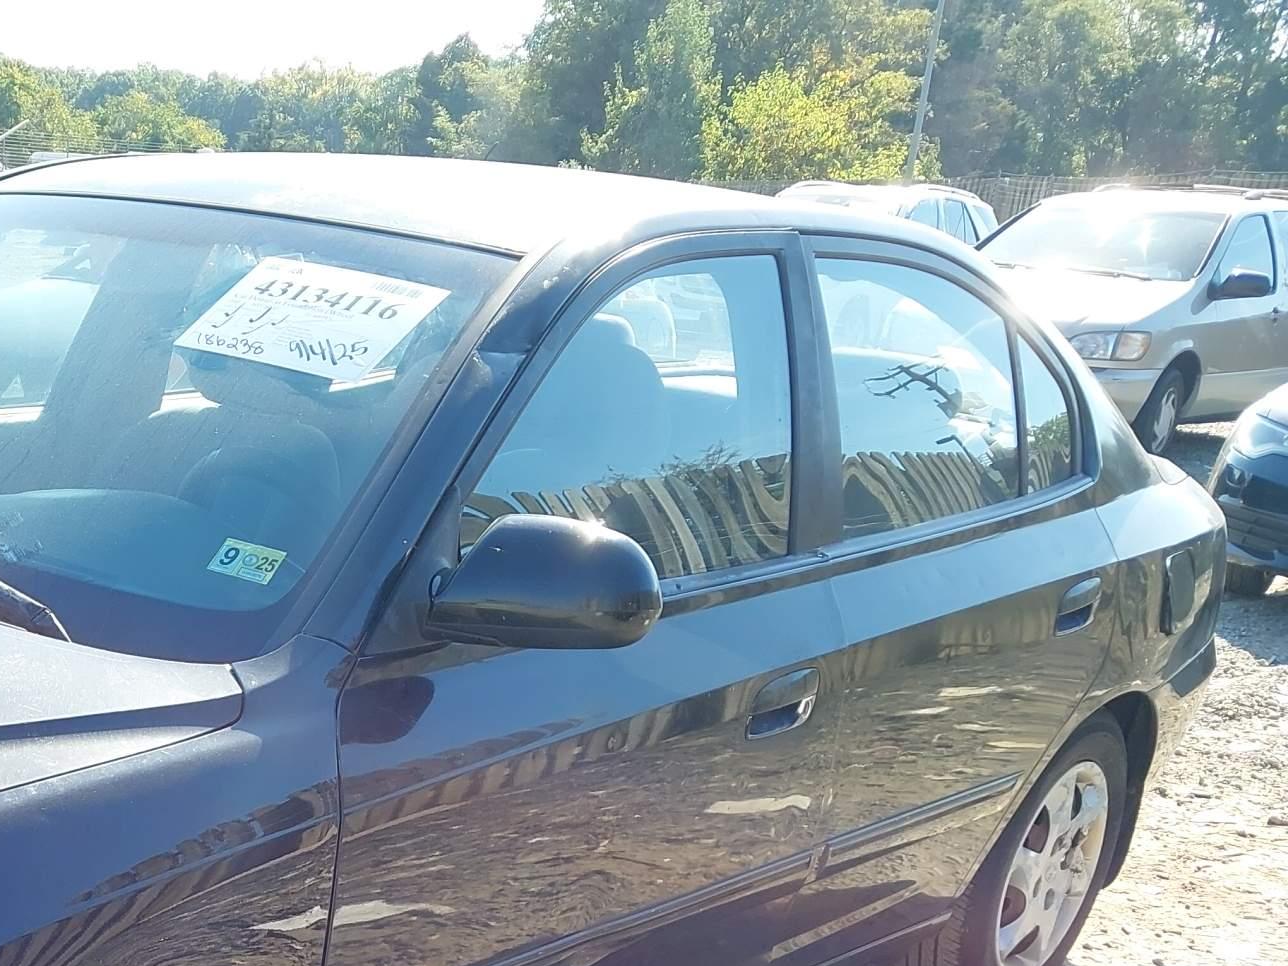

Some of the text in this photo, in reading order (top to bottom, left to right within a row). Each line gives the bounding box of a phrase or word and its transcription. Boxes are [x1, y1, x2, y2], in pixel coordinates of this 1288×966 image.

[254, 280, 408, 320] 43134116
[218, 547, 279, 573] 9 25
